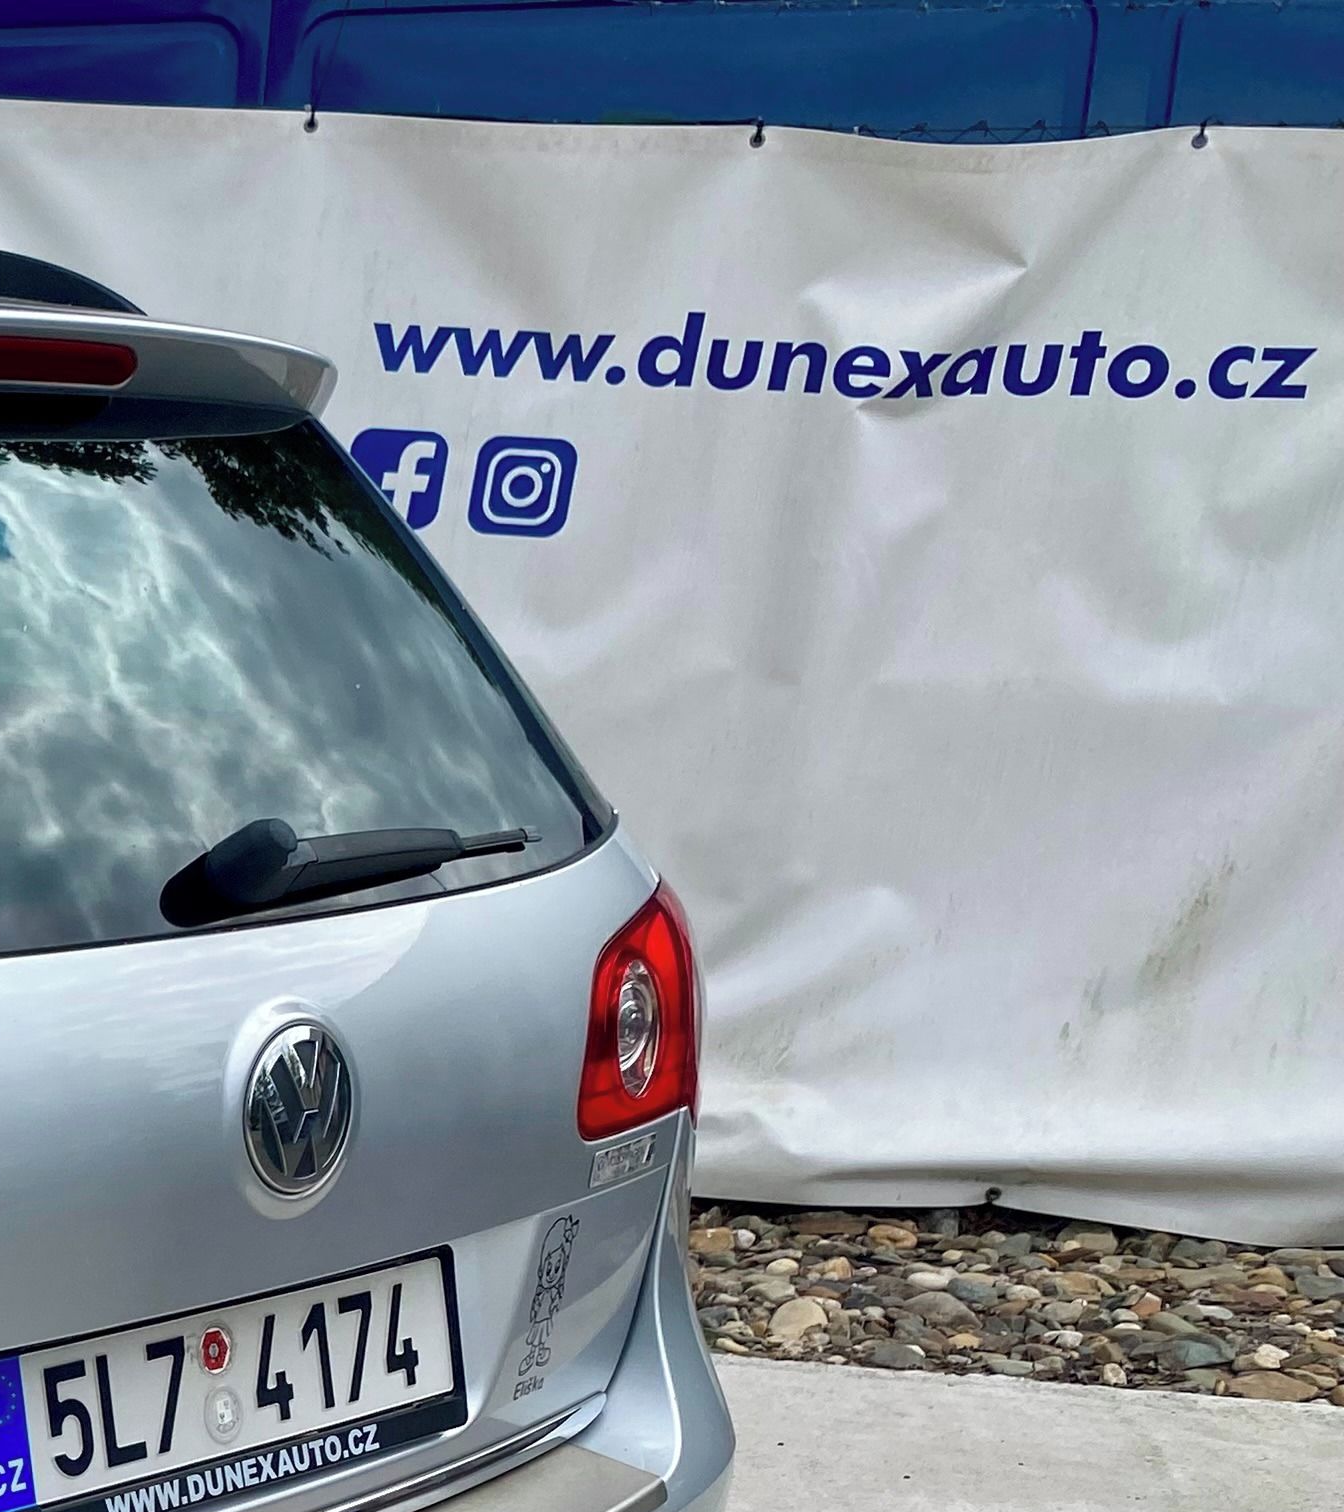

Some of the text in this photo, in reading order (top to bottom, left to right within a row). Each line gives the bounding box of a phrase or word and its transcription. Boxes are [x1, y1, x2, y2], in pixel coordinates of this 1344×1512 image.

[373, 311, 1318, 402] www.dunexauto.cz
[42, 1282, 419, 1477] 5L7 4174
